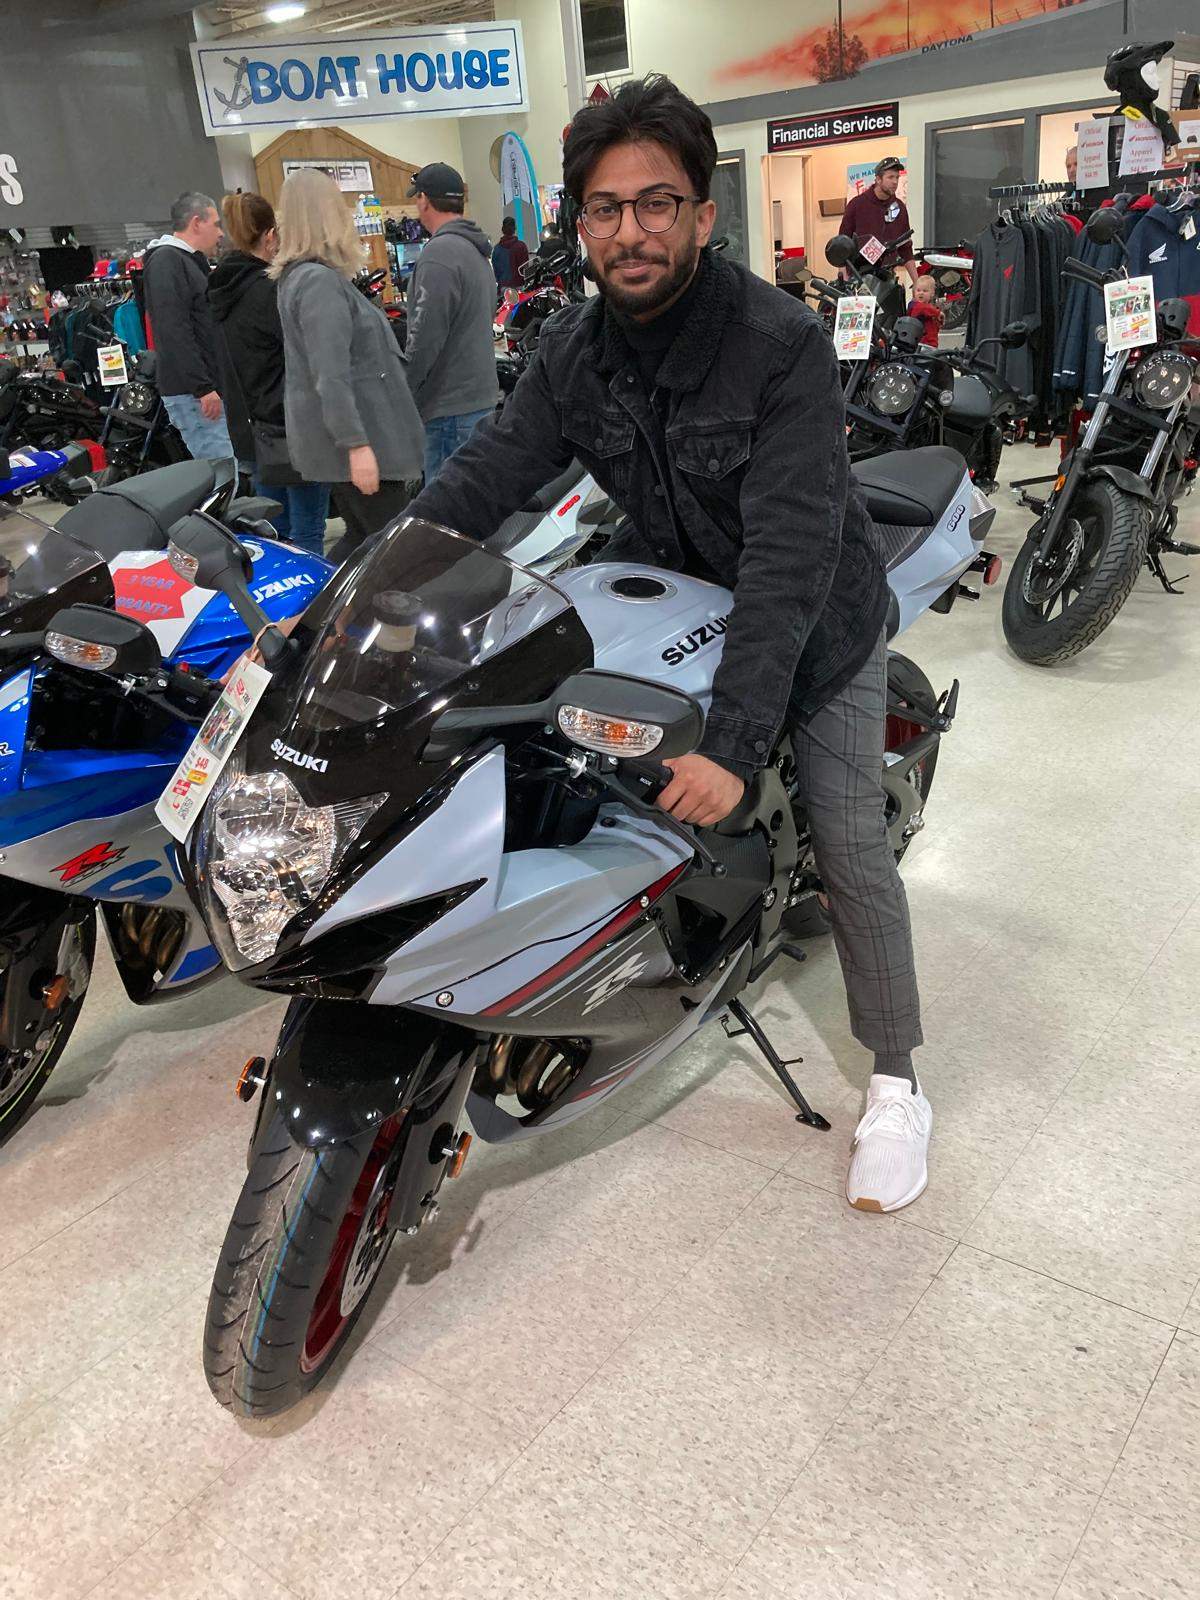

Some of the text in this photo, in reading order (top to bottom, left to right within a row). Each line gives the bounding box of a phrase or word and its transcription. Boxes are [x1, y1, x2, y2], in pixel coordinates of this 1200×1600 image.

[921, 35, 974, 54] DAYTONA
[247, 49, 510, 105] BOAT HOUSE
[772, 115, 894, 145] Financial Services
[270, 738, 329, 773] SUZUKI
